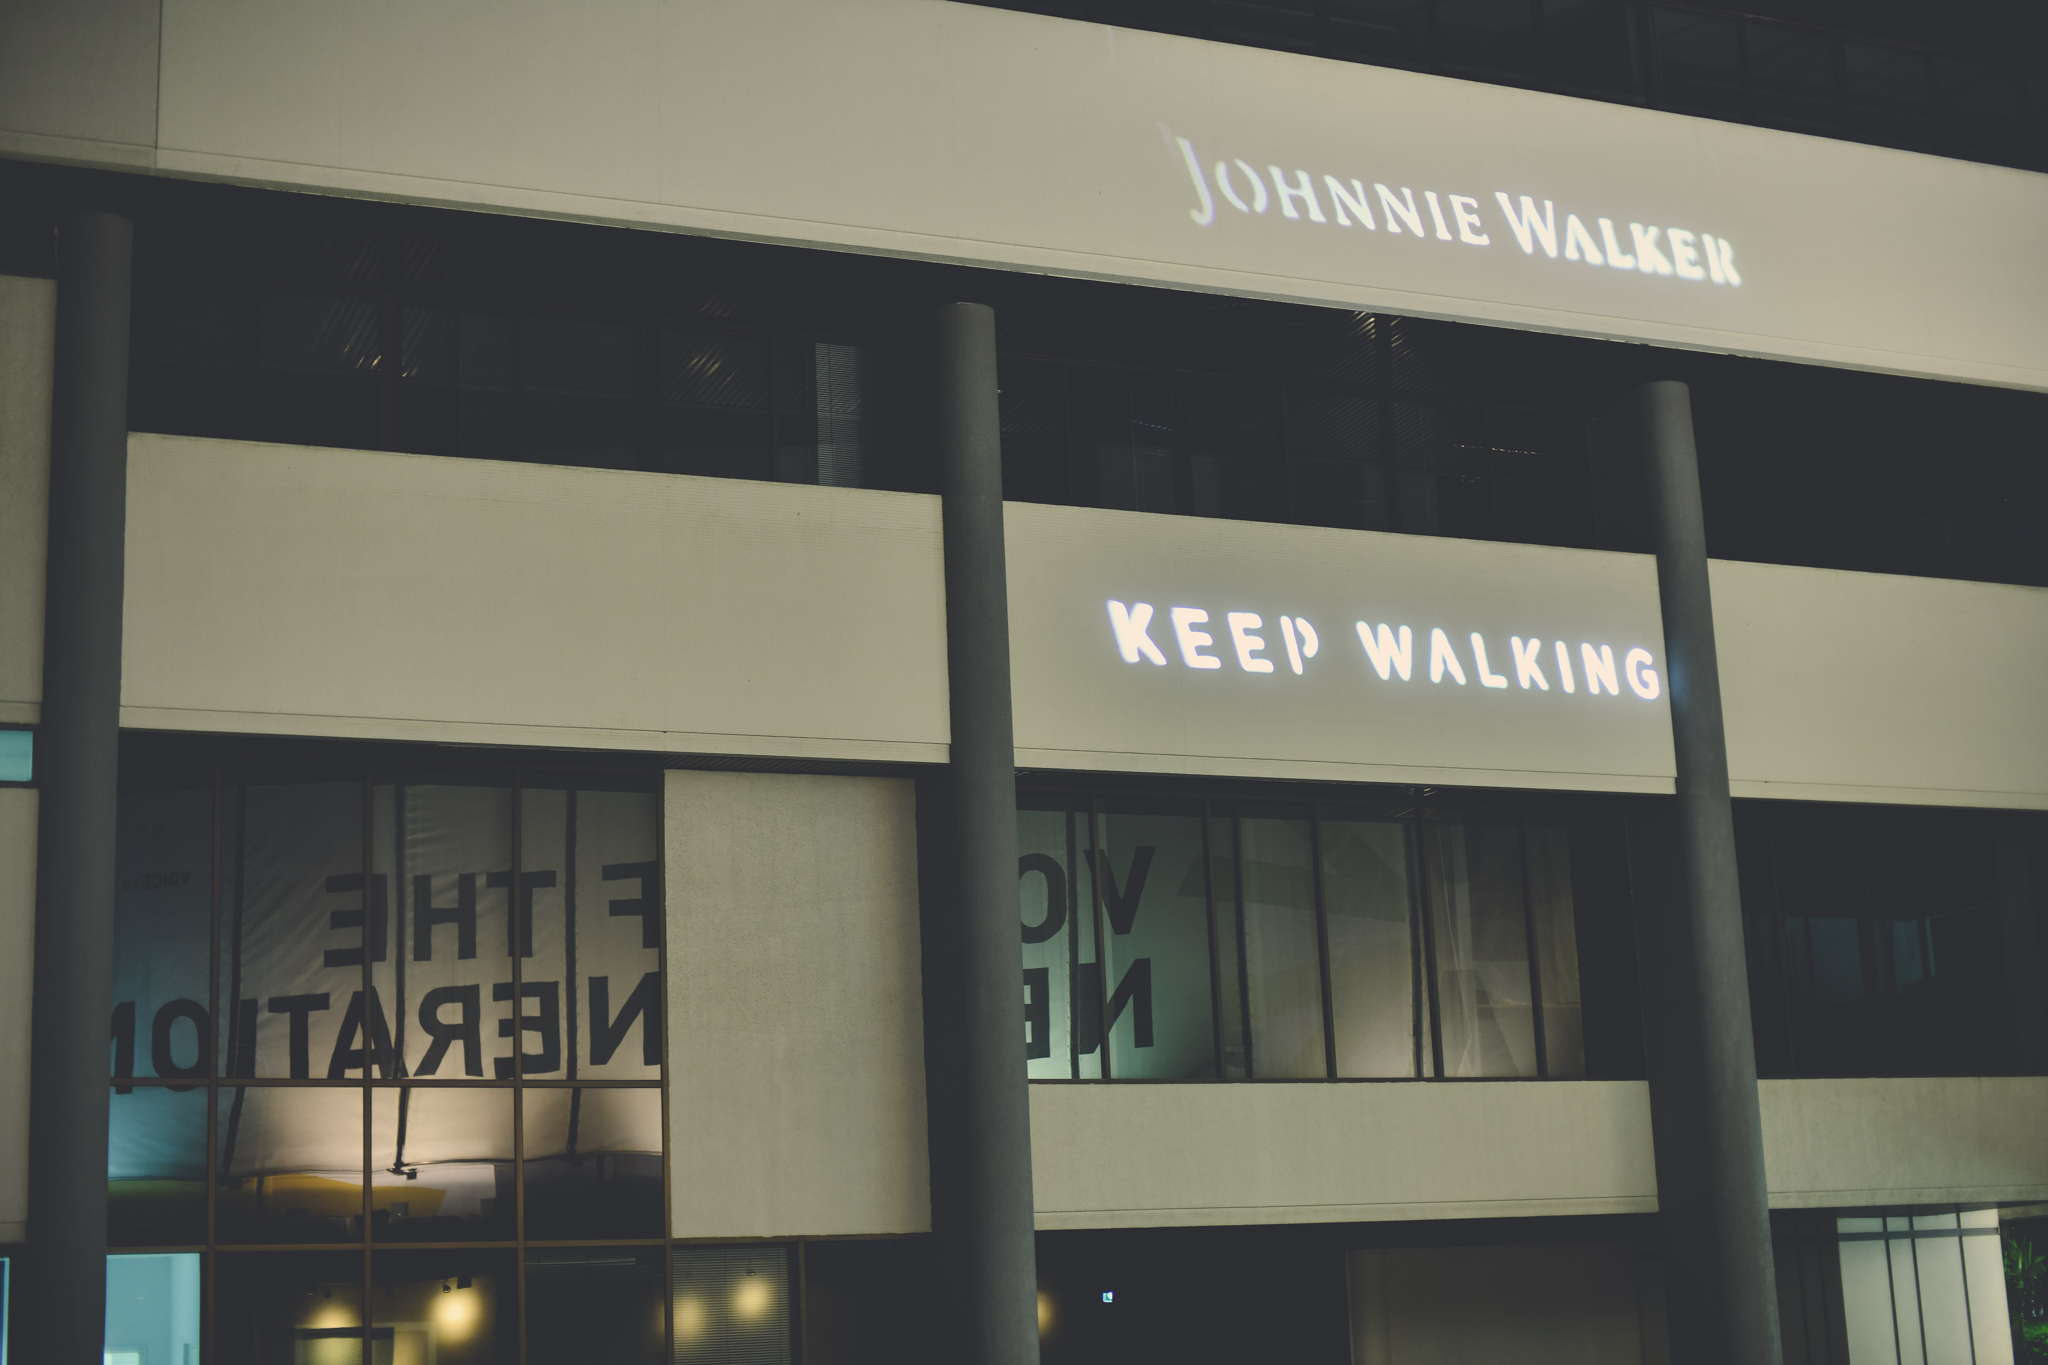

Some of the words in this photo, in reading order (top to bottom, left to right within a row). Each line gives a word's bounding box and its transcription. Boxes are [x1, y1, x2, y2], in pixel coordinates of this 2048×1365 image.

[1166, 128, 1490, 246] JOHNNIE
[1495, 191, 1742, 287] WALKER
[1106, 599, 1320, 676] KEEP
[1355, 620, 1661, 700] WALKING
